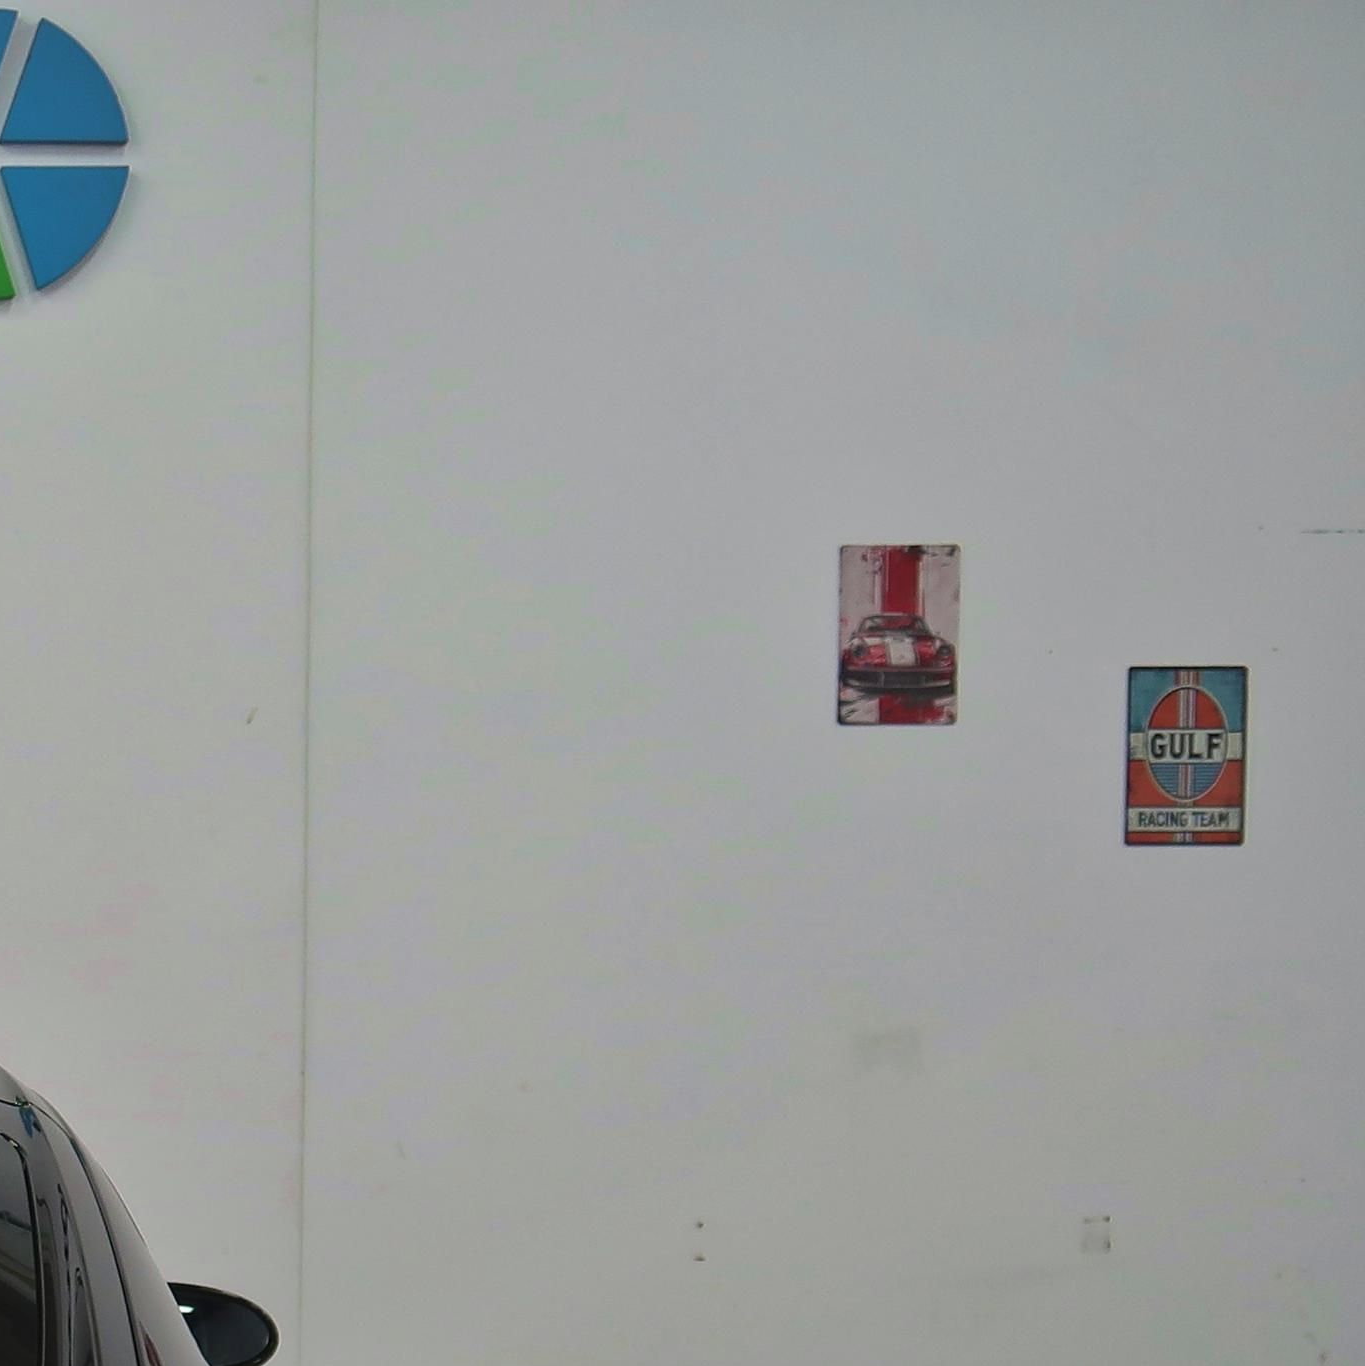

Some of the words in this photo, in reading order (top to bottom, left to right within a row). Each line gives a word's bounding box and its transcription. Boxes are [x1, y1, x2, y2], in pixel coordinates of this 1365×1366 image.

[1150, 732, 1224, 759] GULF
[1138, 811, 1188, 828] RACING
[1192, 811, 1230, 827] TEAM
